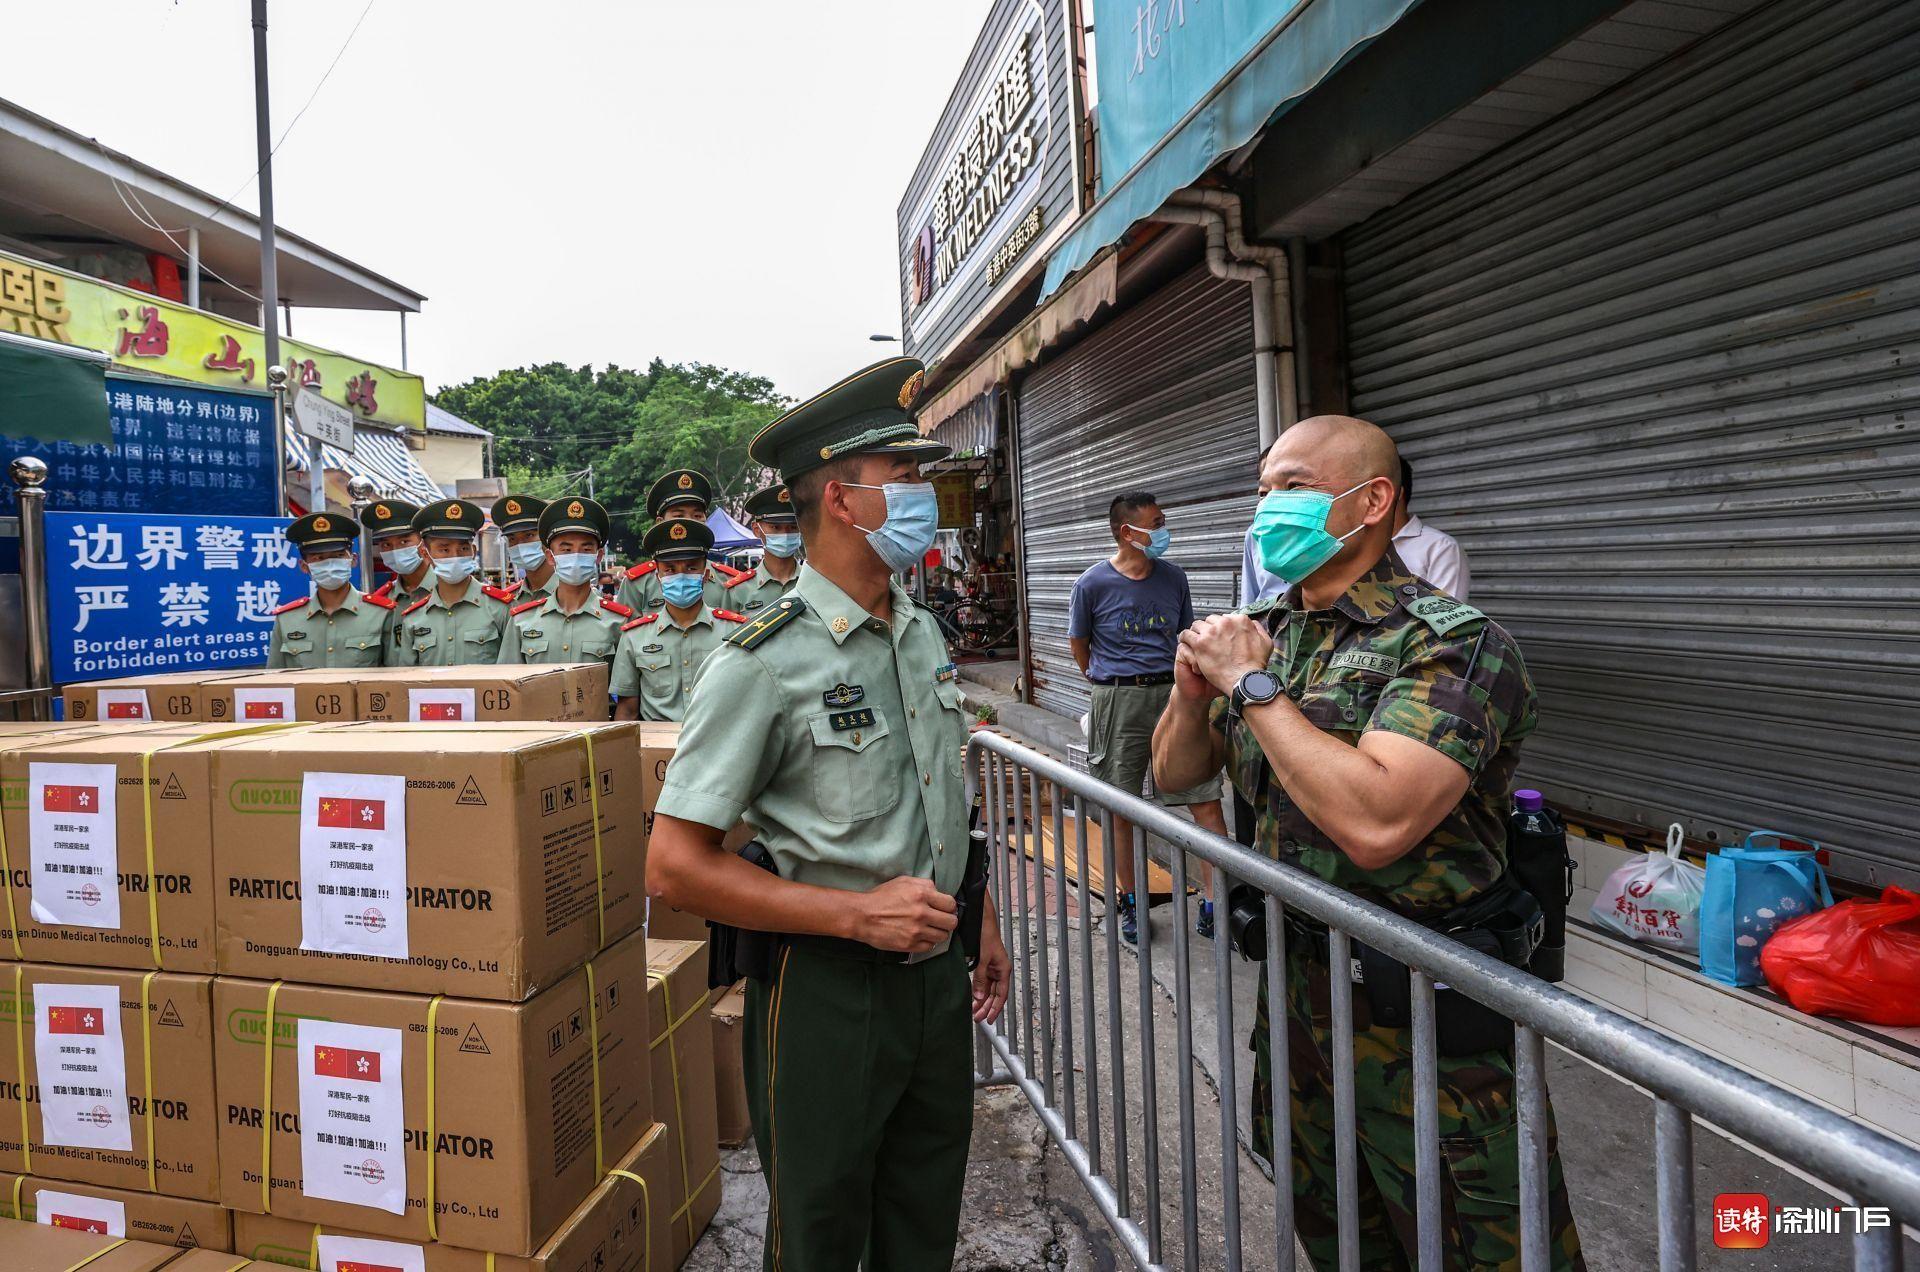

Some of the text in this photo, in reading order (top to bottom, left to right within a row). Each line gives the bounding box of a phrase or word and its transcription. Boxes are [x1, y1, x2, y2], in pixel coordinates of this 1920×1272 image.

[936, 119, 1033, 286] WK WELLNESS
[985, 205, 1040, 287] 香港中英街3號
[69, 523, 298, 570] 边界警戒
[73, 580, 317, 633] 严禁越
[74, 636, 148, 654] Border
[154, 631, 200, 648] alert
[205, 630, 254, 644] areas
[74, 650, 179, 672] forbidden
[185, 648, 205, 663] to
[210, 646, 258, 661] cross
[168, 696, 192, 715] GB
[316, 695, 341, 714] GB
[483, 689, 510, 711] GB
[407, 780, 456, 790] GB2626-2006
[32, 928, 59, 940] Dinuo
[61, 930, 97, 942] Medical
[99, 932, 152, 947] Technolog
[159, 936, 178, 949] Co.,
[181, 937, 198, 949] Ltd
[1657, 929, 1683, 939] HUO
[246, 941, 299, 957] Dongguan
[452, 957, 476, 972] Co.,
[479, 959, 499, 973] Ltd
[464, 1043, 485, 1051] MEDICAL
[227, 1104, 302, 1134] PARICU
[29, 1142, 55, 1155] Dinuo
[57, 1148, 94, 1161] Medical
[96, 1151, 149, 1170] Technolog
[155, 1160, 175, 1174] Co.,
[177, 1161, 194, 1174] Ltd
[243, 1170, 296, 1190] Donguan
[451, 1201, 475, 1218] Co.,
[479, 1205, 499, 1219] Ltd
